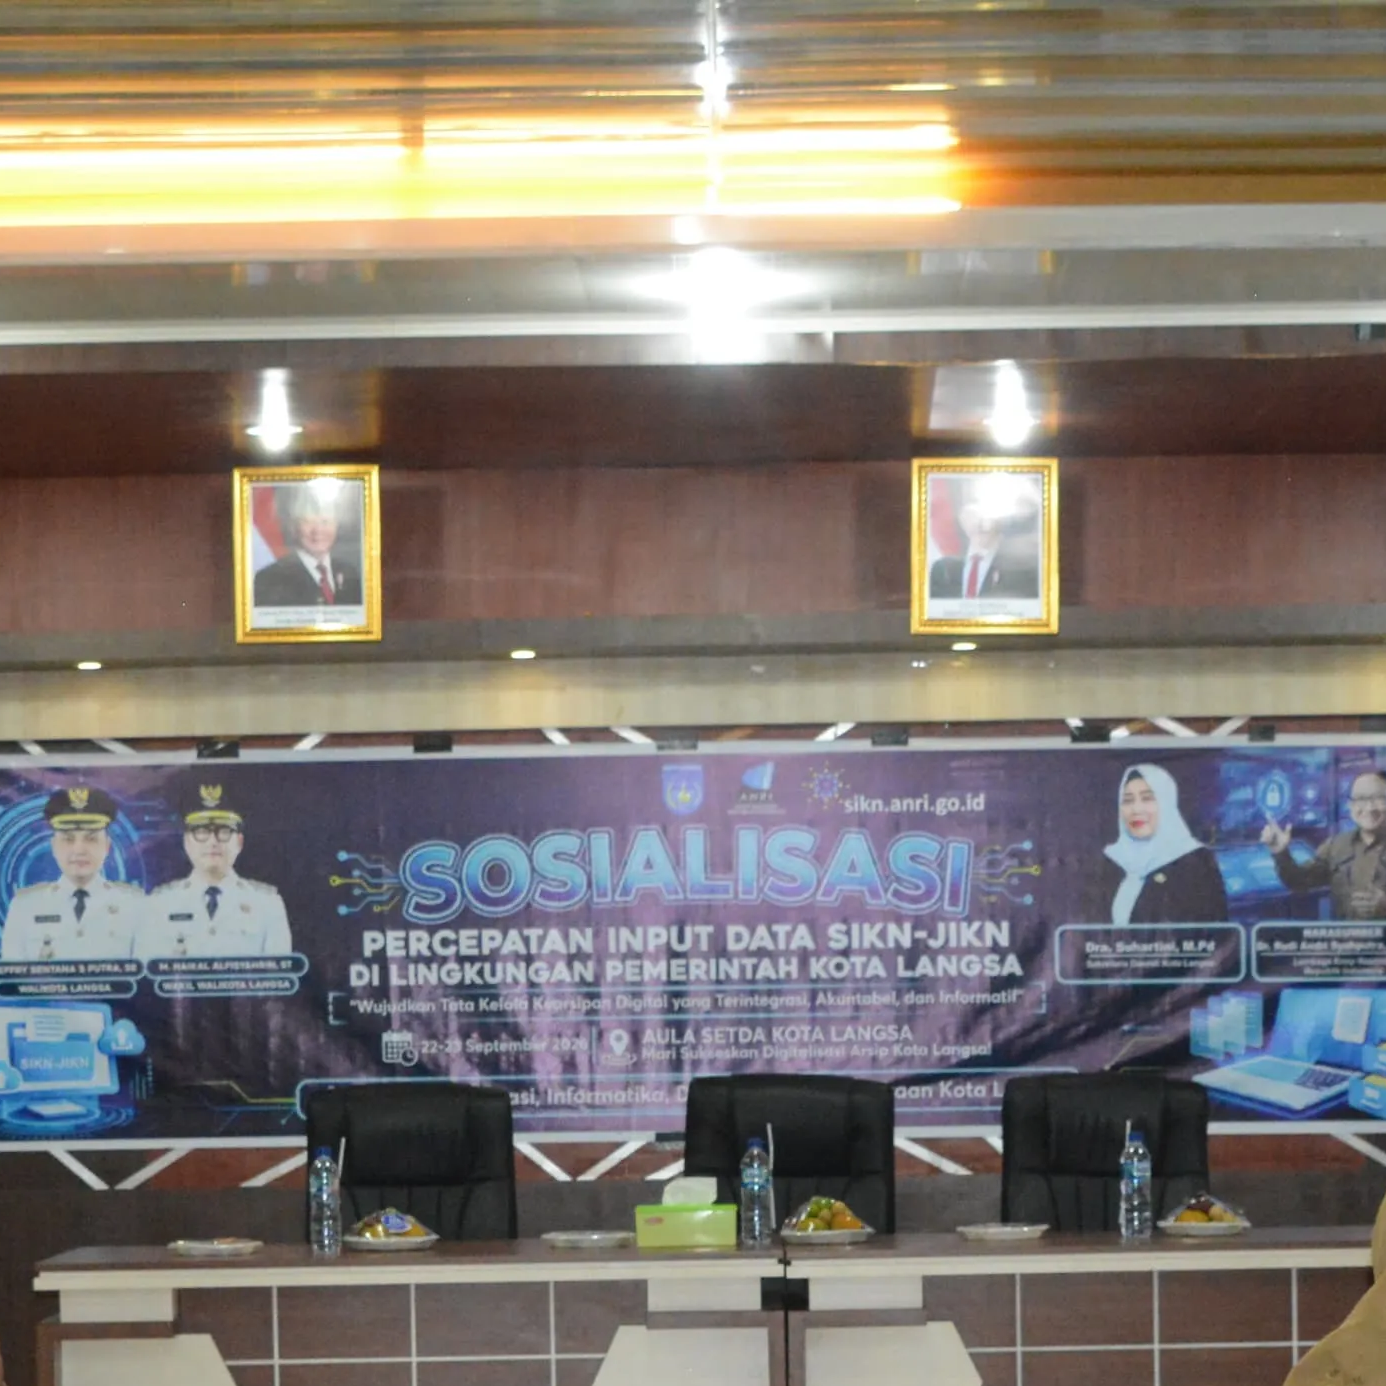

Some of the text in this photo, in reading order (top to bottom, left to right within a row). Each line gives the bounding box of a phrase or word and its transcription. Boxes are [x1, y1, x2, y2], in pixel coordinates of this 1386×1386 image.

[844, 793, 985, 816] sikn.anri.go.id
[400, 824, 974, 925] SOSIALISASI
[363, 921, 1010, 957] PERCEPATAN INPUT DATA SIKN-JIKN
[350, 953, 1024, 987] DI LINGKUNGAN PEMERINTAH KOTA LANGSA
[441, 999, 474, 1013] Tata
[615, 994, 668, 1011] Digital
[673, 997, 711, 1010] yang
[716, 993, 812, 1010] Terintegrasi,
[816, 991, 901, 1007] Akuntabel,
[904, 990, 935, 1005] dan
[642, 1023, 914, 1044] AULA SETDA KOTA LANGSA
[465, 1038, 545, 1056] September
[642, 1046, 676, 1060] Mari
[850, 1043, 888, 1059] Arsip
[893, 1042, 928, 1056] Kota
[20, 1056, 90, 1071] SIKN-JIKN
[546, 1086, 669, 1106] Informatika,
[939, 1083, 987, 1099] Kota
